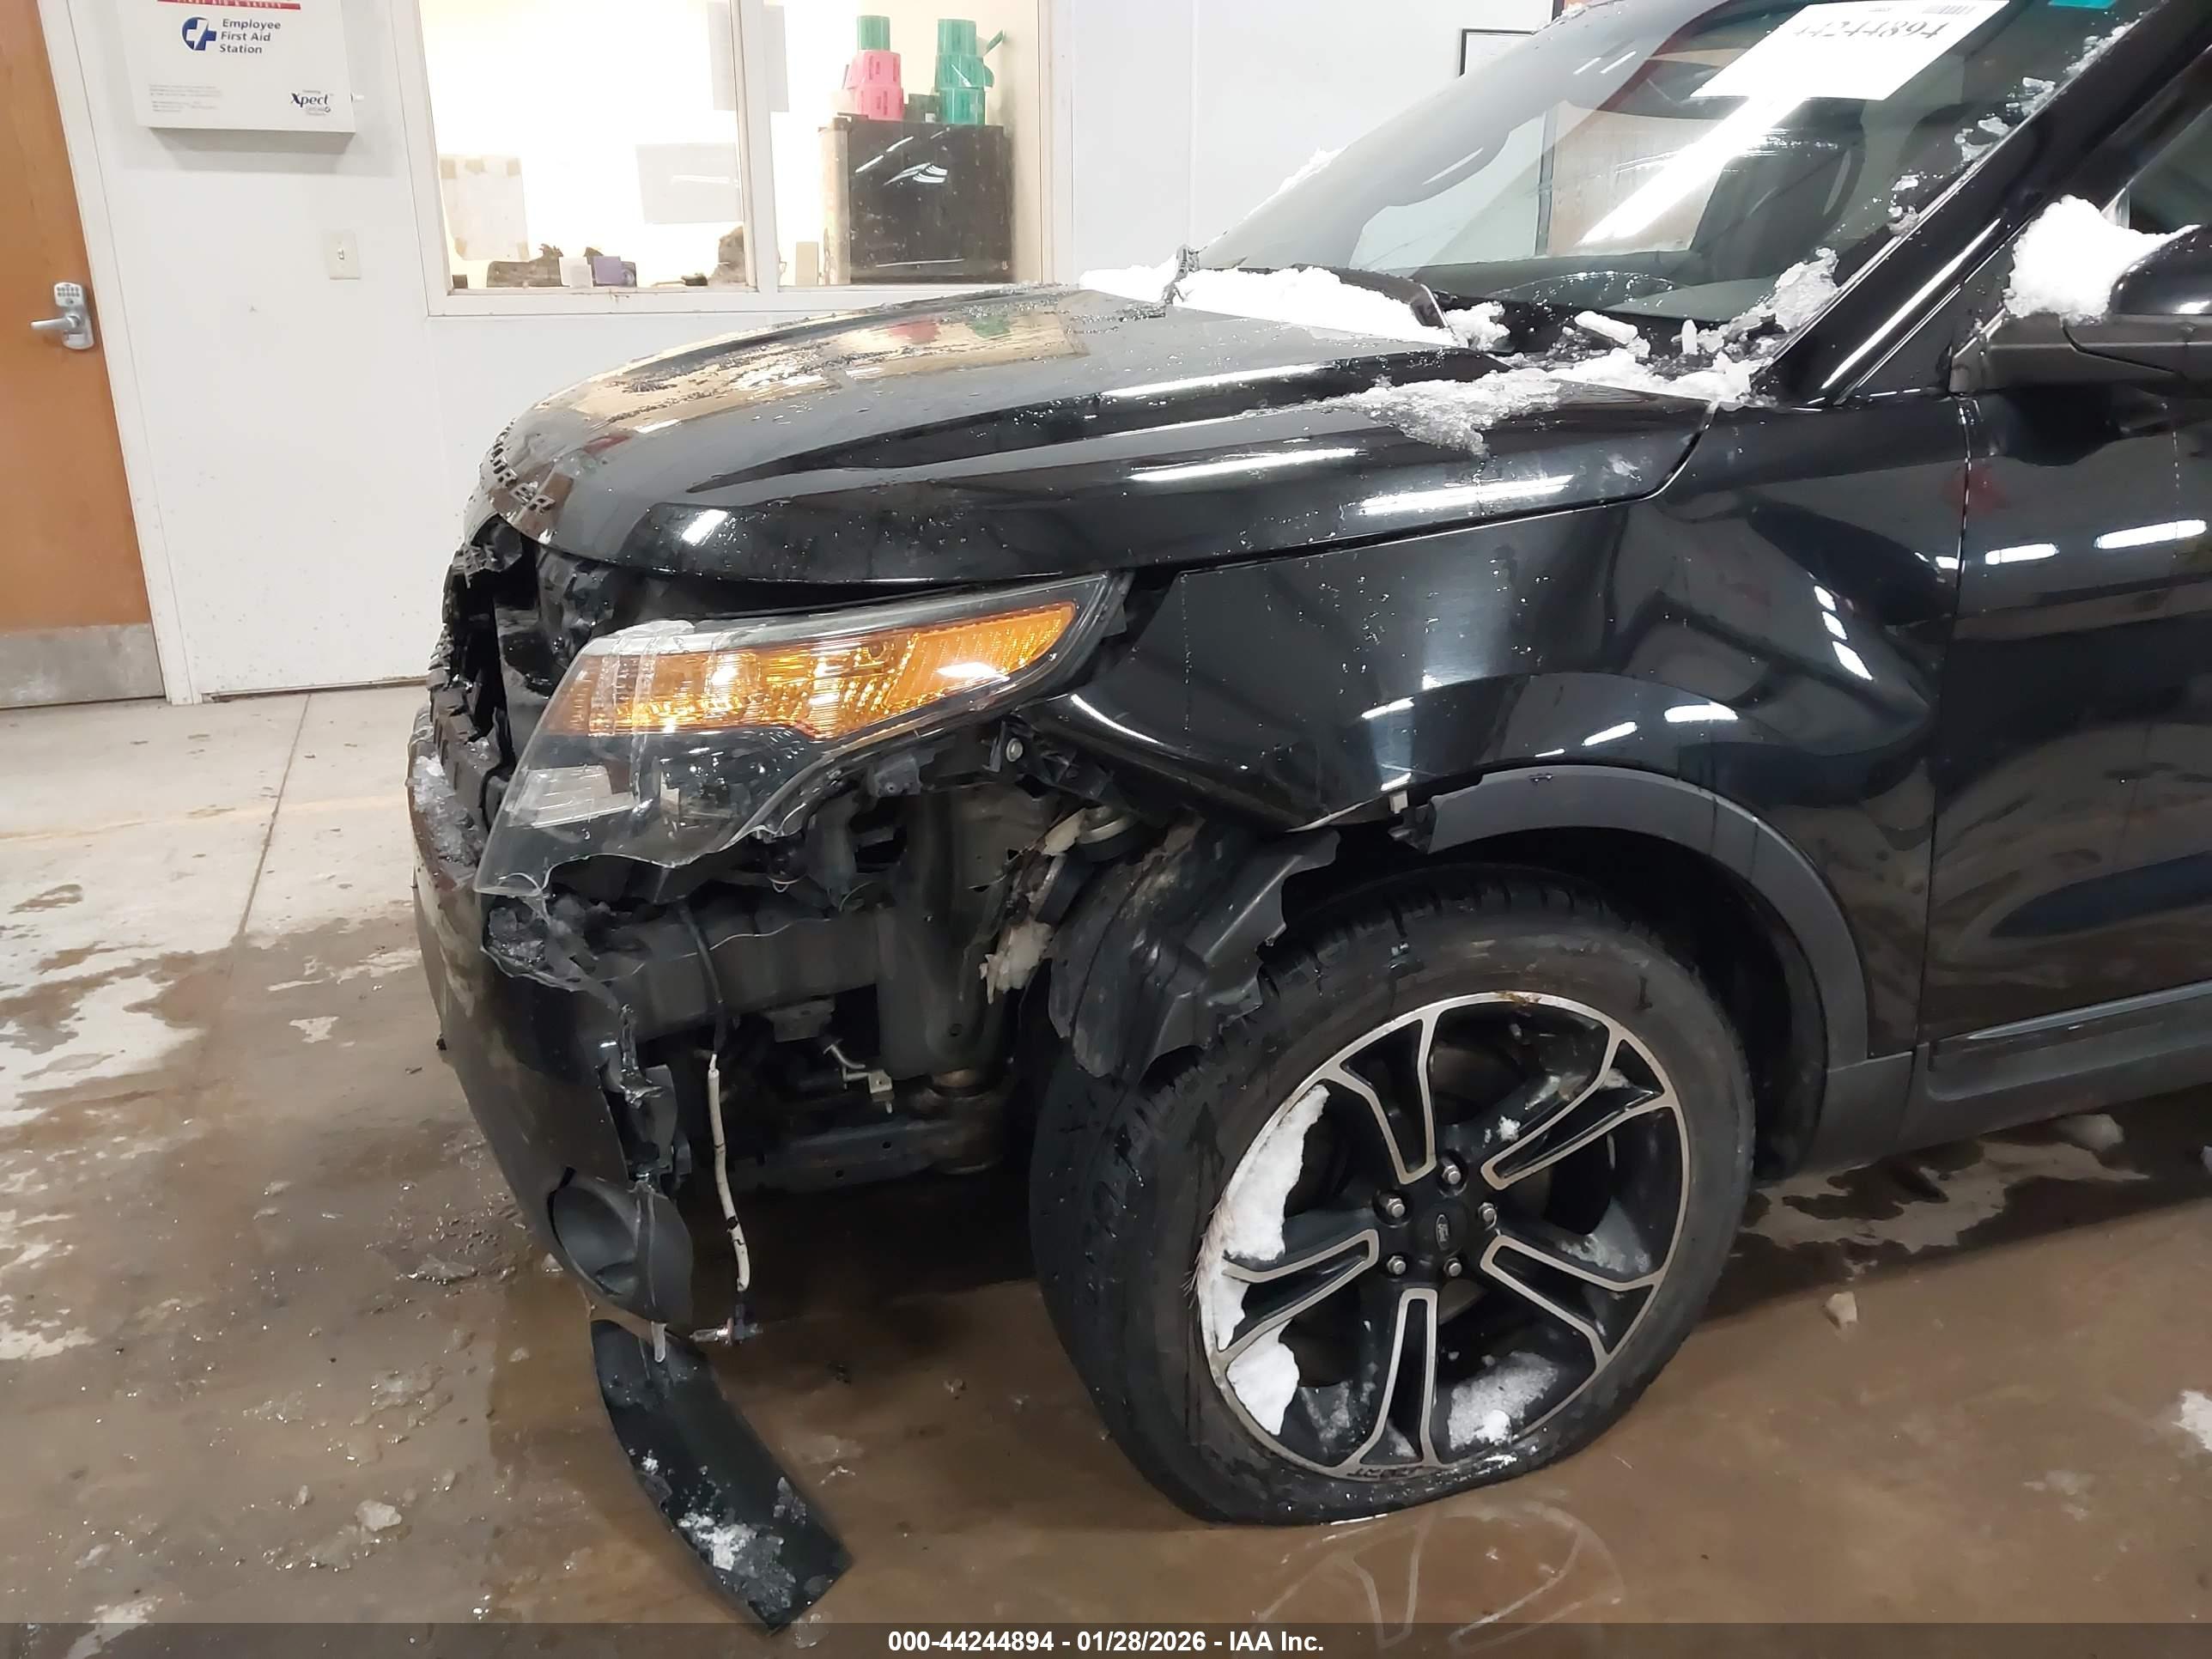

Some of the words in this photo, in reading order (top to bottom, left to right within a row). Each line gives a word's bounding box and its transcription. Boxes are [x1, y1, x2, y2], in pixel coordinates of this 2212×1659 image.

[222, 18, 282, 32] Employee
[221, 31, 247, 42] First
[250, 33, 271, 43] Aid
[219, 43, 263, 55] Station
[290, 92, 329, 108] Xpect
